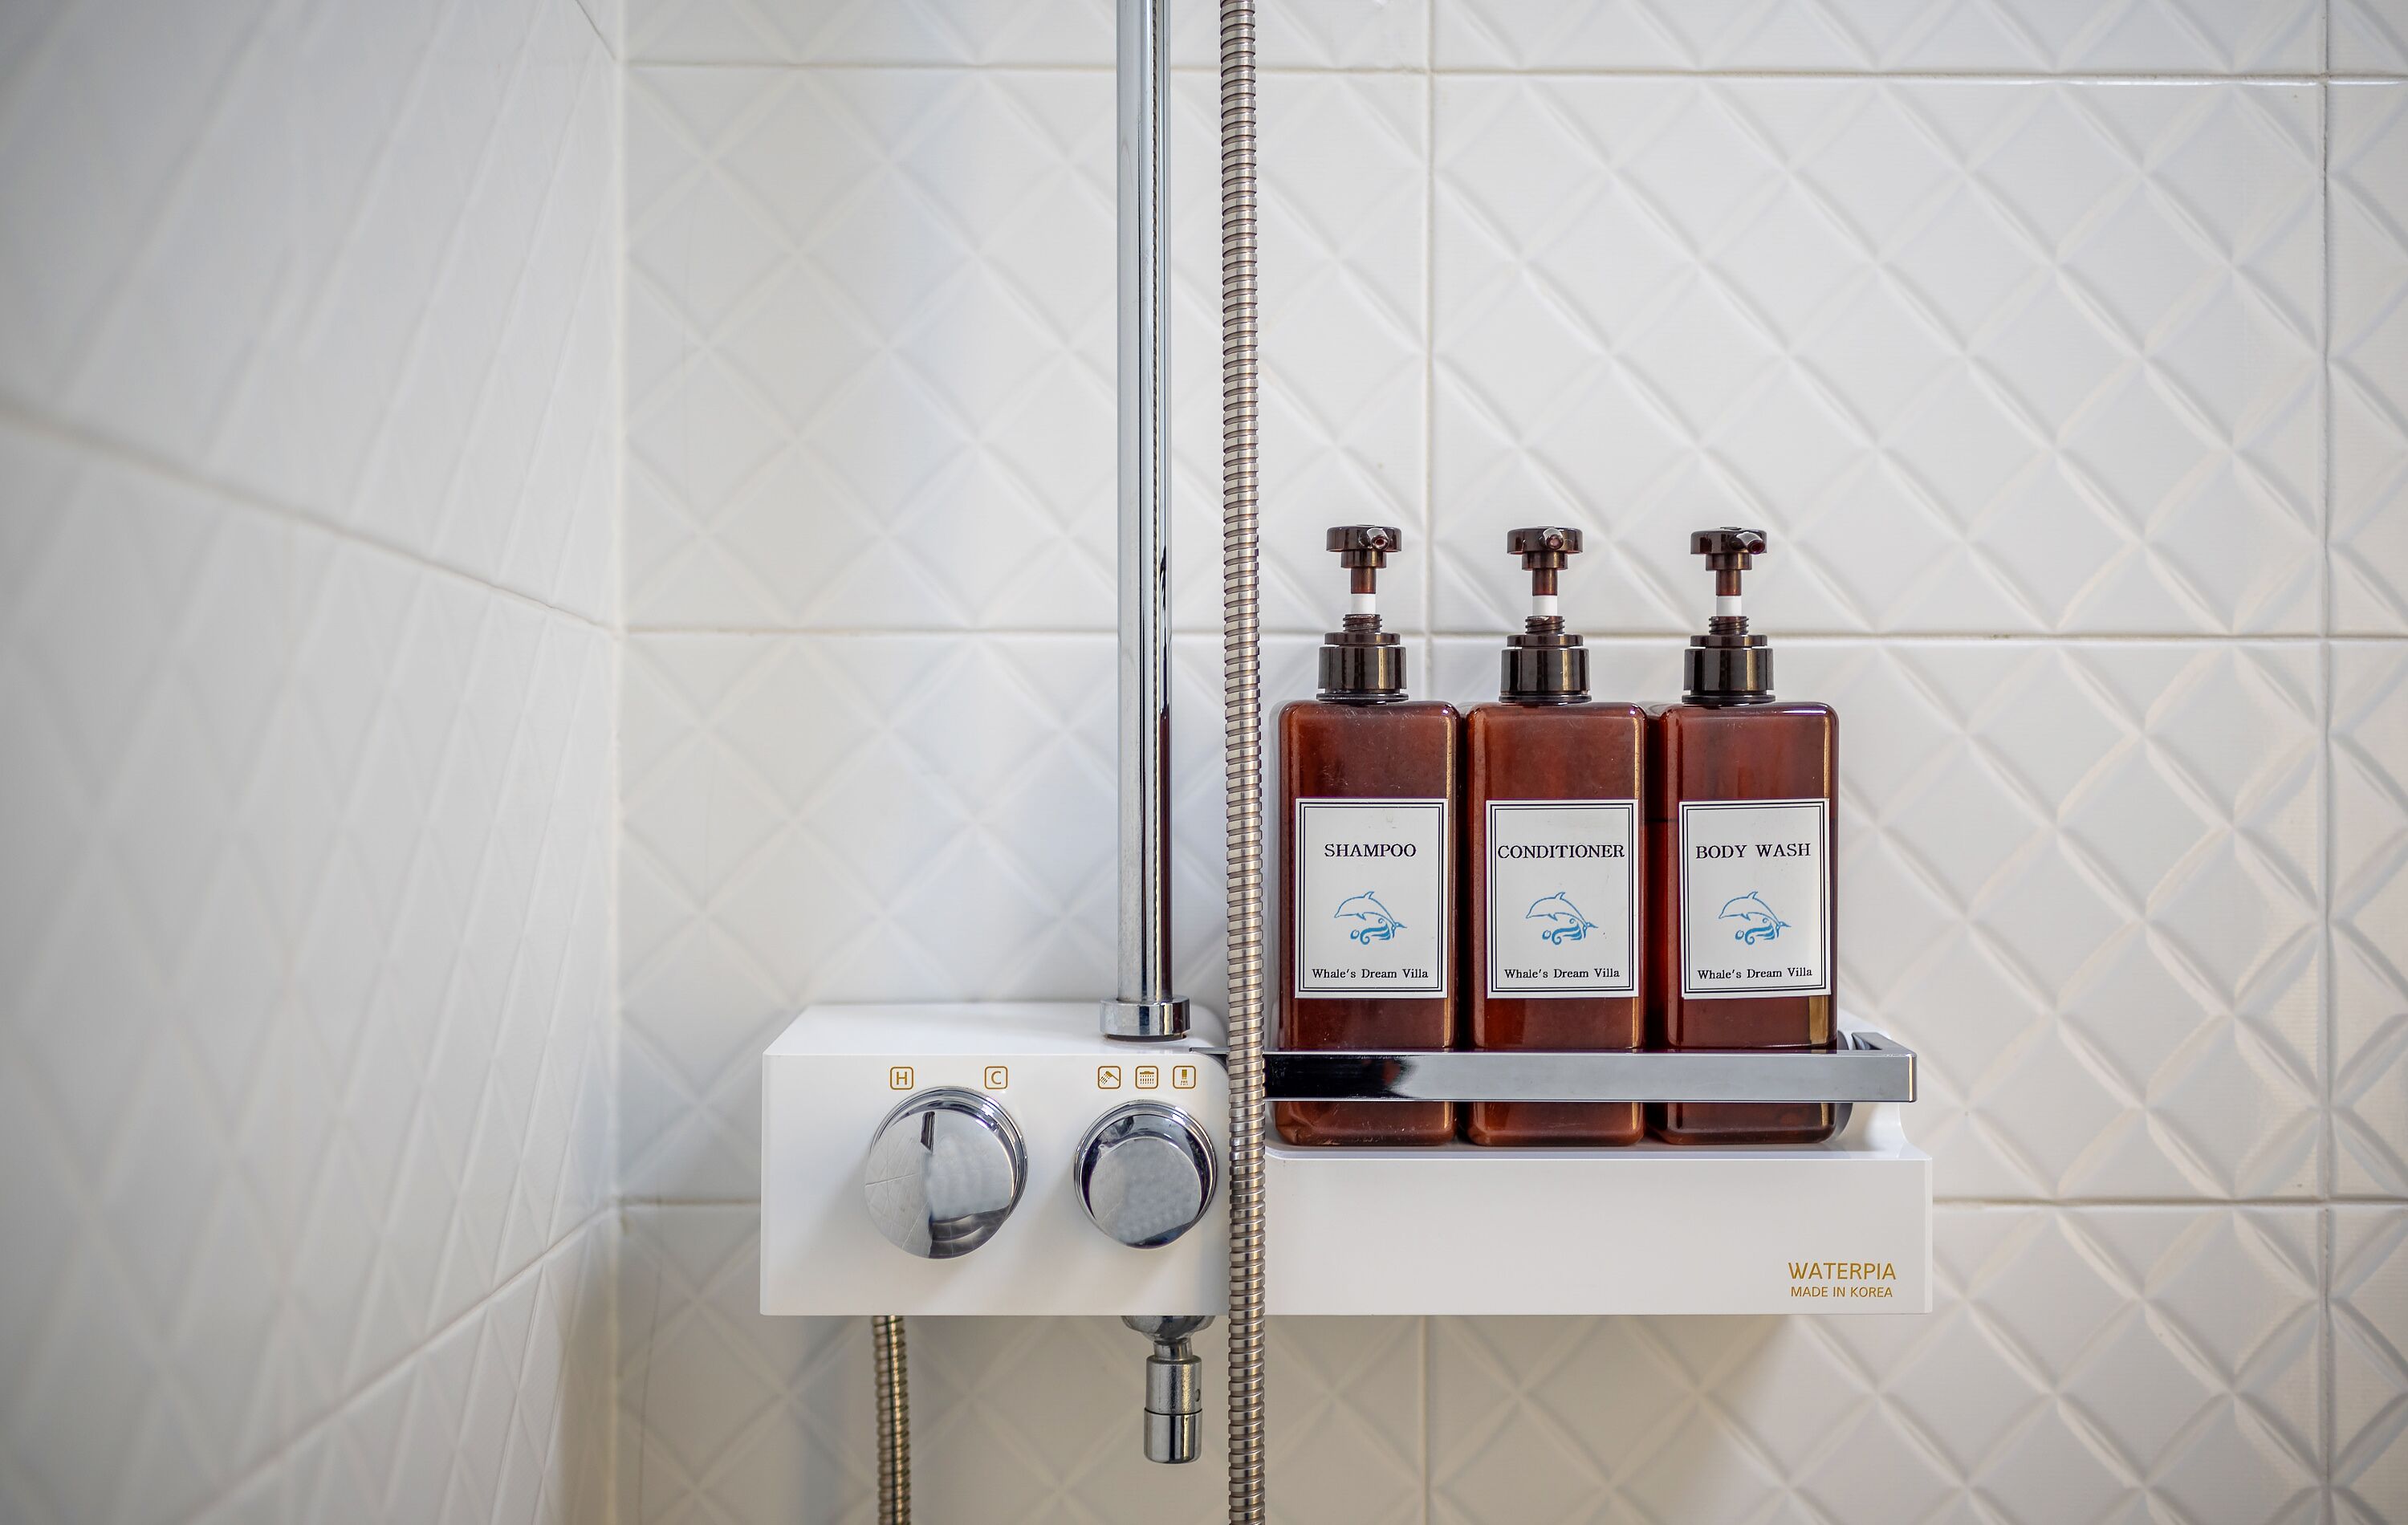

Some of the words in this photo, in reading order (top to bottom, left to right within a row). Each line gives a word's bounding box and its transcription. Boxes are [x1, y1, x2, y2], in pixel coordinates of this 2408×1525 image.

[1324, 844, 1417, 857] SHAMPOO
[1498, 844, 1625, 859] CONDITIONER
[1696, 844, 1747, 859] BODY
[1755, 843, 1811, 857] WASH
[1312, 968, 1357, 978] Whale's
[1361, 969, 1397, 978] Dream
[1402, 968, 1429, 978] Villa
[1504, 969, 1548, 978] Whale's
[1553, 969, 1589, 978] Dream
[1594, 968, 1620, 978] Villa
[1698, 970, 1742, 979] Whale's
[1747, 969, 1783, 978] Dream
[1788, 967, 1812, 977] Villa
[896, 1072, 908, 1085] H
[990, 1071, 1002, 1085] C
[1788, 1263, 1896, 1280] WATERPIA
[1791, 1287, 1828, 1297] MADE
[1832, 1287, 1845, 1297] IN
[1850, 1287, 1893, 1298] KOREA
